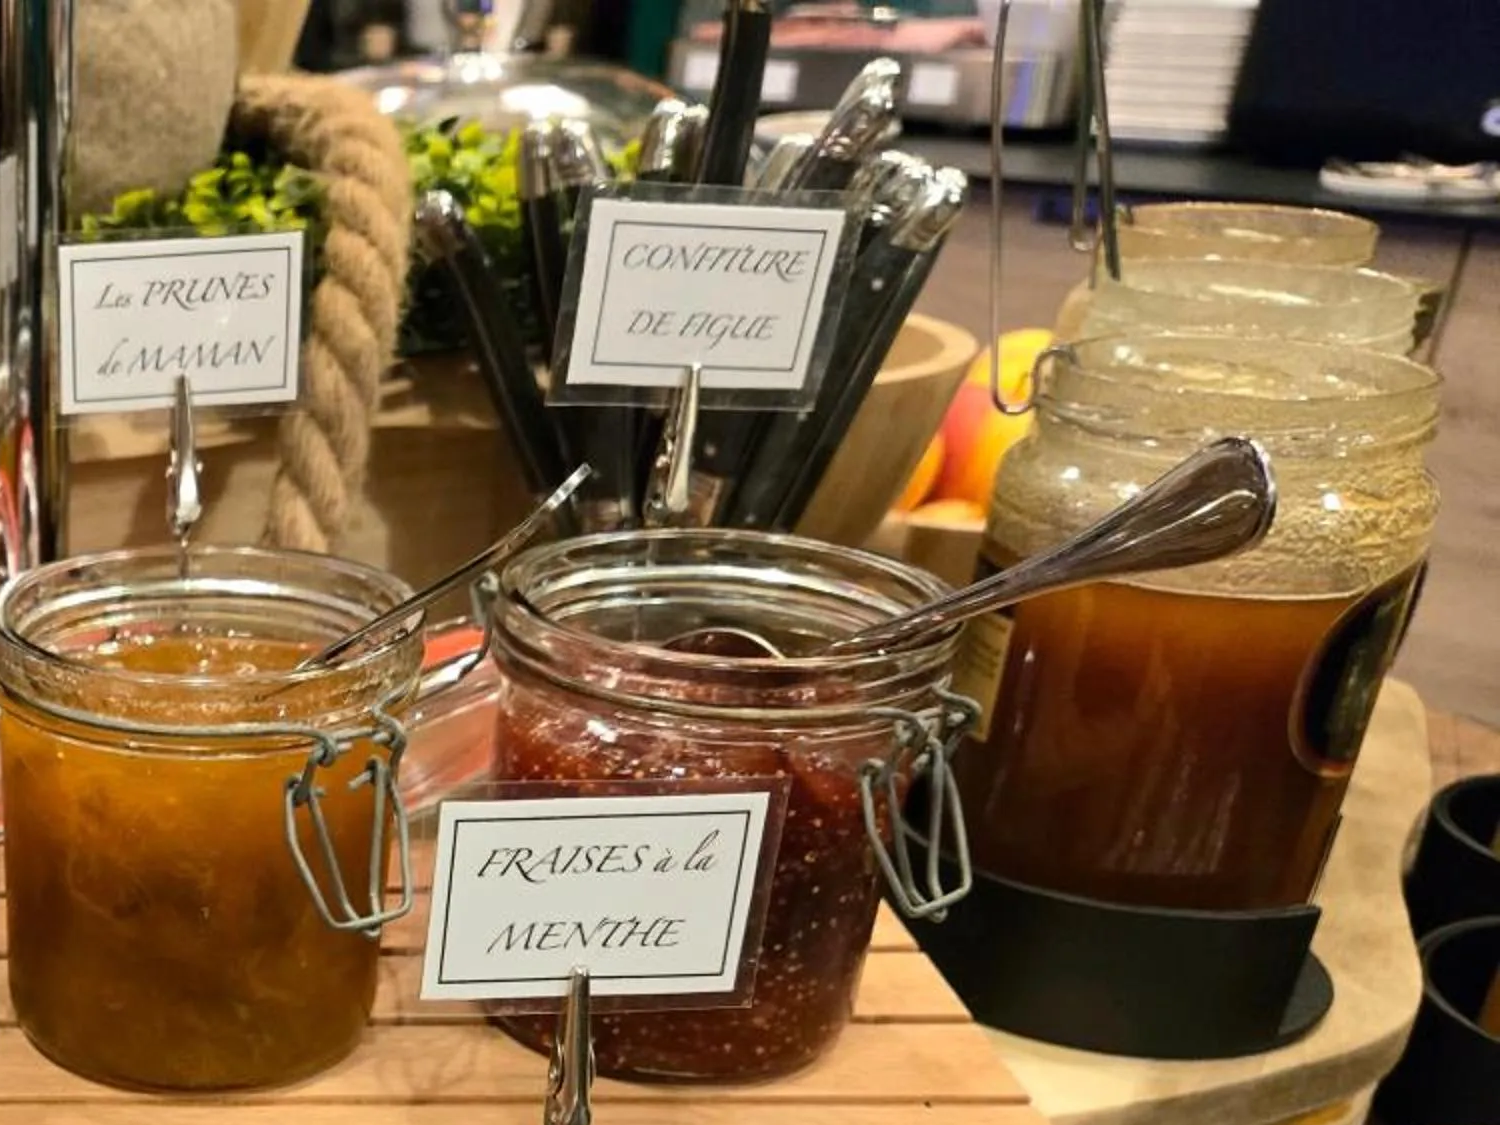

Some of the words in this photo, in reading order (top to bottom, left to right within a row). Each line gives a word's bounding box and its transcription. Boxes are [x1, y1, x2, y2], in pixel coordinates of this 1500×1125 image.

[622, 242, 810, 282] CONFITURE
[94, 282, 132, 310] Les
[142, 272, 275, 312] PRUNES
[626, 310, 676, 336] DE
[677, 311, 779, 350] FIGUE
[97, 337, 129, 376] de
[126, 335, 275, 375] MAMAN
[476, 844, 651, 883] FRAISES
[653, 848, 680, 874] à
[682, 828, 721, 873] la
[486, 915, 686, 953] MENTHE
